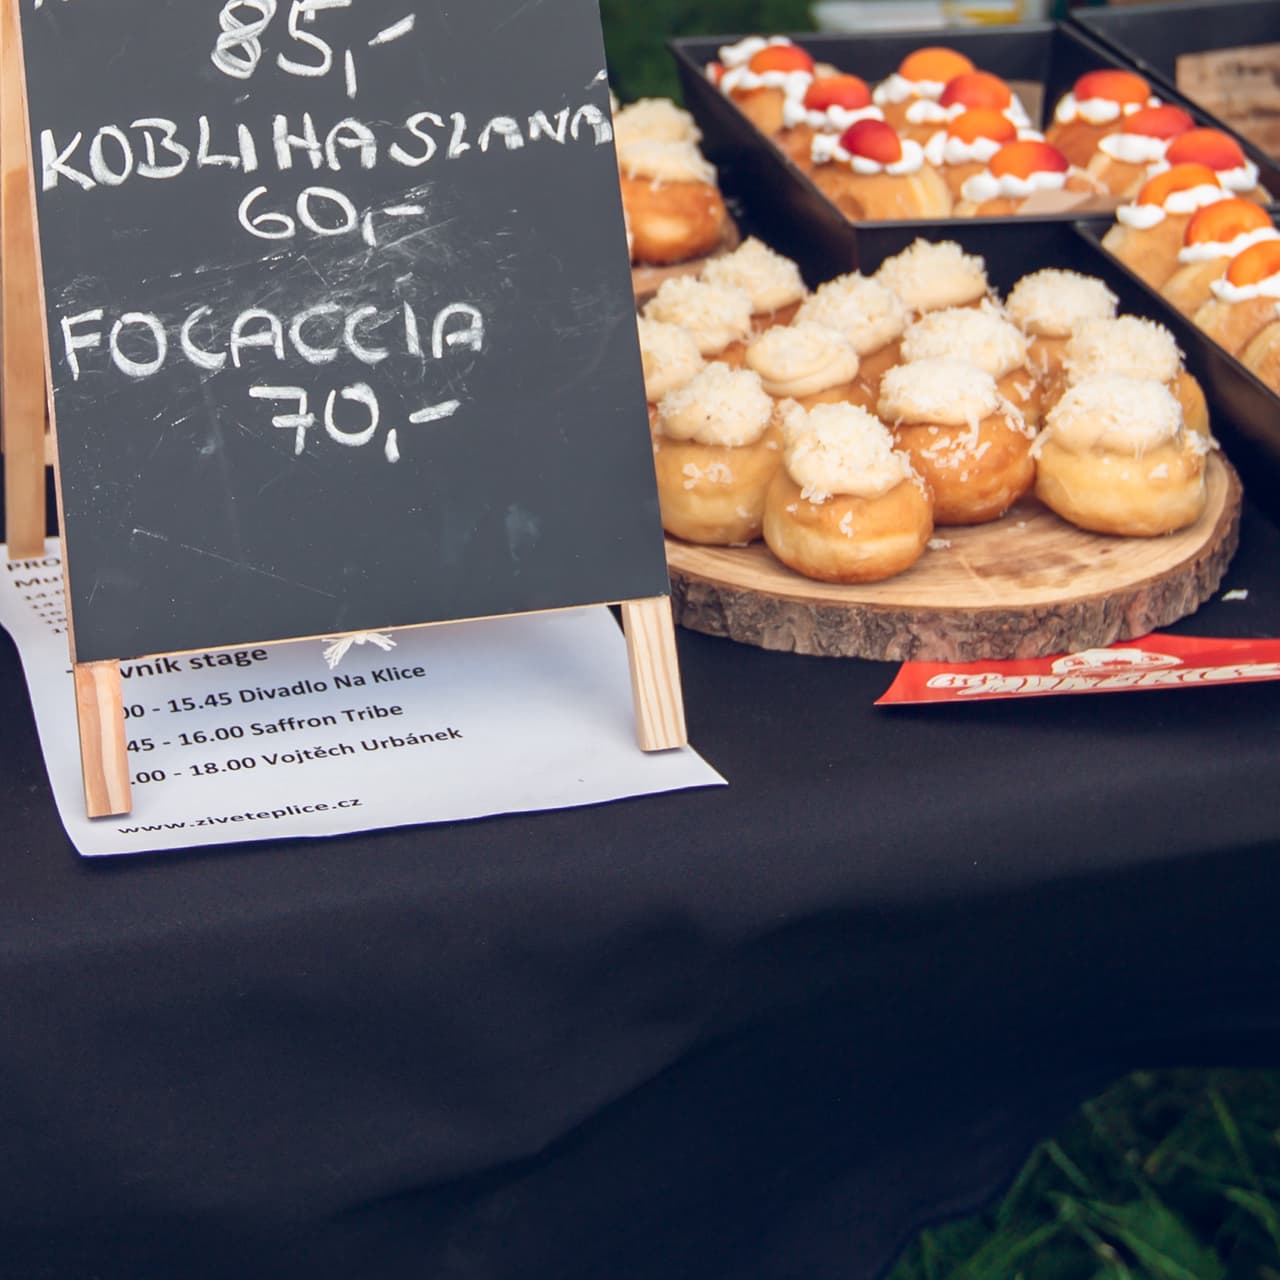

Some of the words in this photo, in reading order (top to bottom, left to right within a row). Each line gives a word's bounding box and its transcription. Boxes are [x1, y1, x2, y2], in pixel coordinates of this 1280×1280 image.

[61, 300, 486, 382] FOCACCIA
[189, 648, 268, 670] stage
[167, 692, 233, 714] 15.45
[239, 680, 328, 704] Divadlo
[333, 674, 366, 690] Na
[371, 666, 427, 684] Klice
[178, 725, 245, 747] 16.00
[250, 714, 337, 737] Saffron
[341, 704, 404, 723] Tribe
[189, 756, 257, 777] 18.00
[262, 743, 355, 765] Vojtěch
[360, 726, 464, 752] Urbánek
[118, 797, 364, 834] www.ziveteplice.cz
